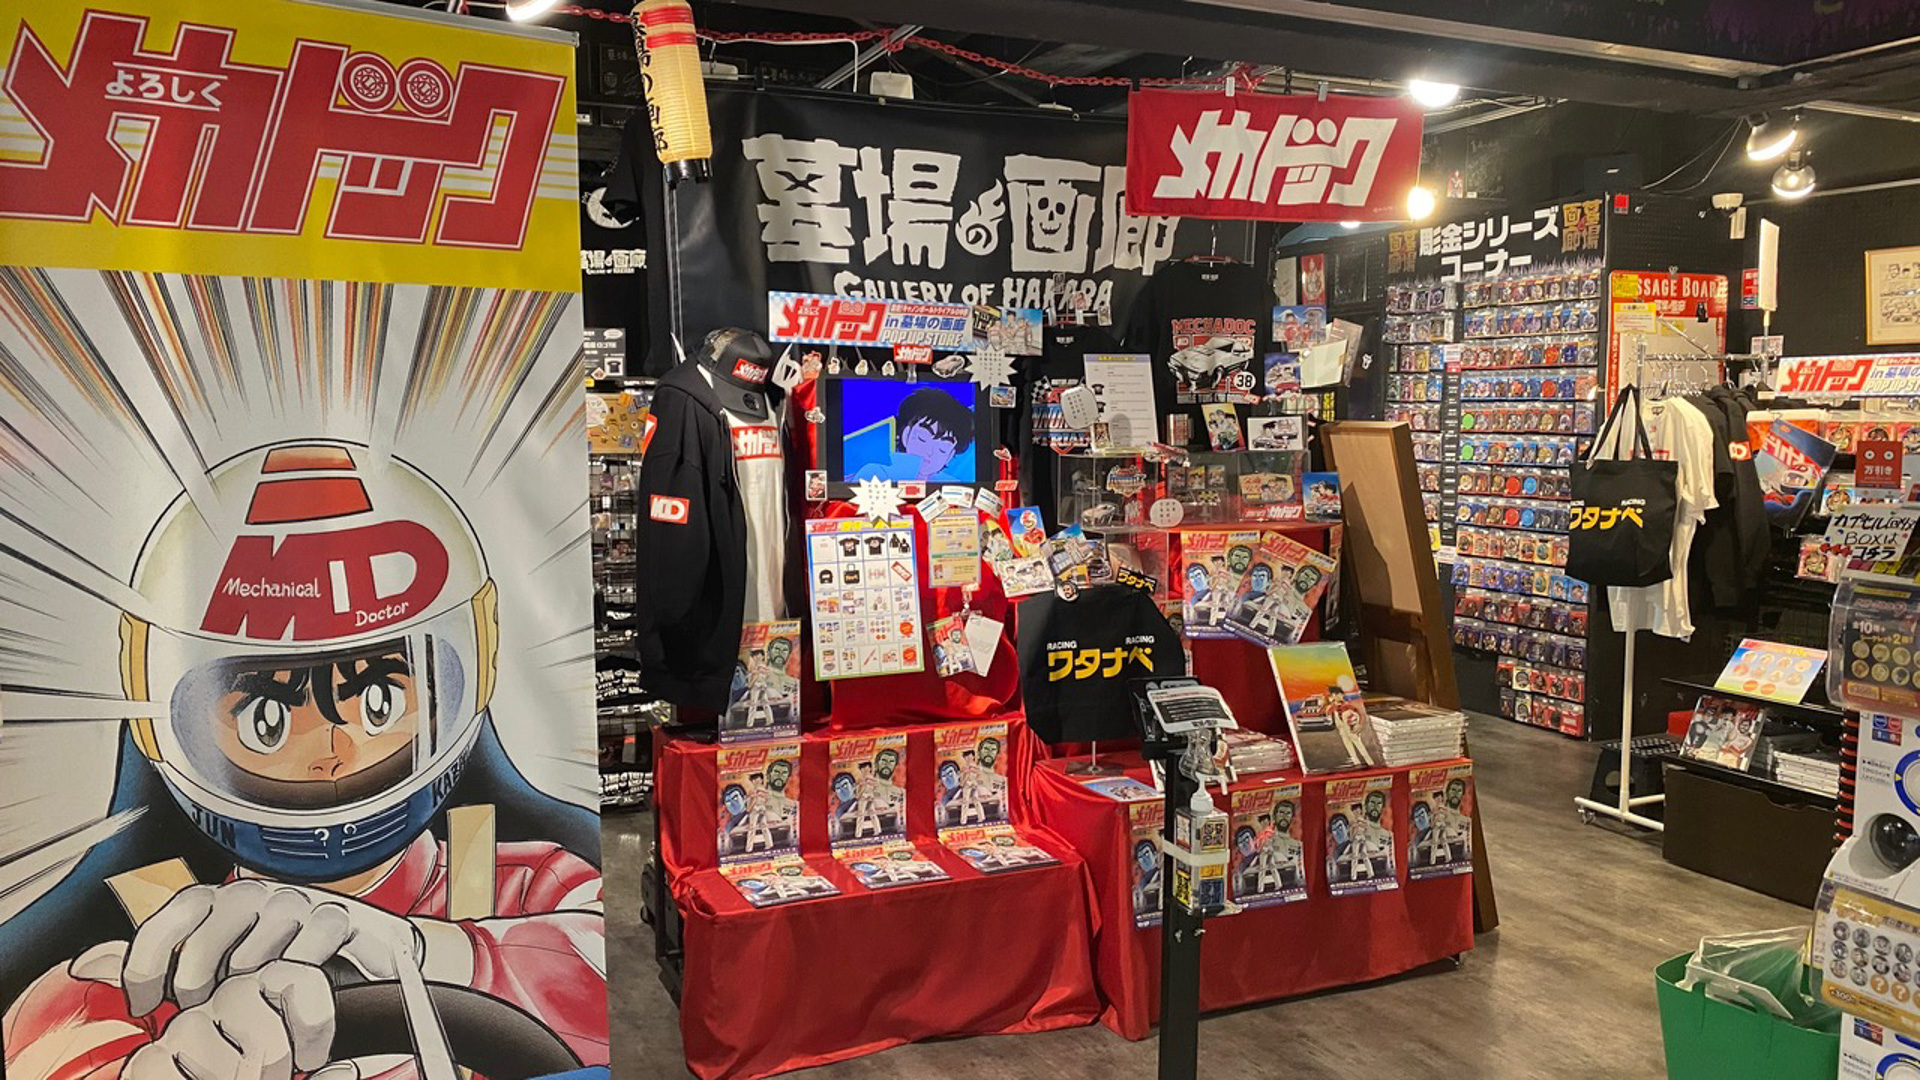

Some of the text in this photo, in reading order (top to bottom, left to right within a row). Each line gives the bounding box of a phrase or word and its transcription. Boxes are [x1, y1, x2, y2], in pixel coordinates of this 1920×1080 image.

[105, 69, 222, 107] よろしく
[1152, 109, 1398, 207] メカドック
[1419, 205, 1559, 257] 彫金シリーズ
[1440, 248, 1532, 284] コーナー
[961, 282, 995, 307] OF
[1638, 276, 1678, 297] SSAGE
[1171, 317, 1257, 334] MECHADOC
[1236, 374, 1253, 388] 38
[1864, 464, 1893, 475] 万引き
[1568, 507, 1643, 530] ワタナベ
[1845, 531, 1897, 545] BOXは
[221, 577, 321, 599] Mechanical
[355, 600, 409, 627] Doctor
[1047, 635, 1155, 651] RACING RACING
[1048, 646, 1154, 682] ワタナベ
[191, 803, 236, 849] JUN
